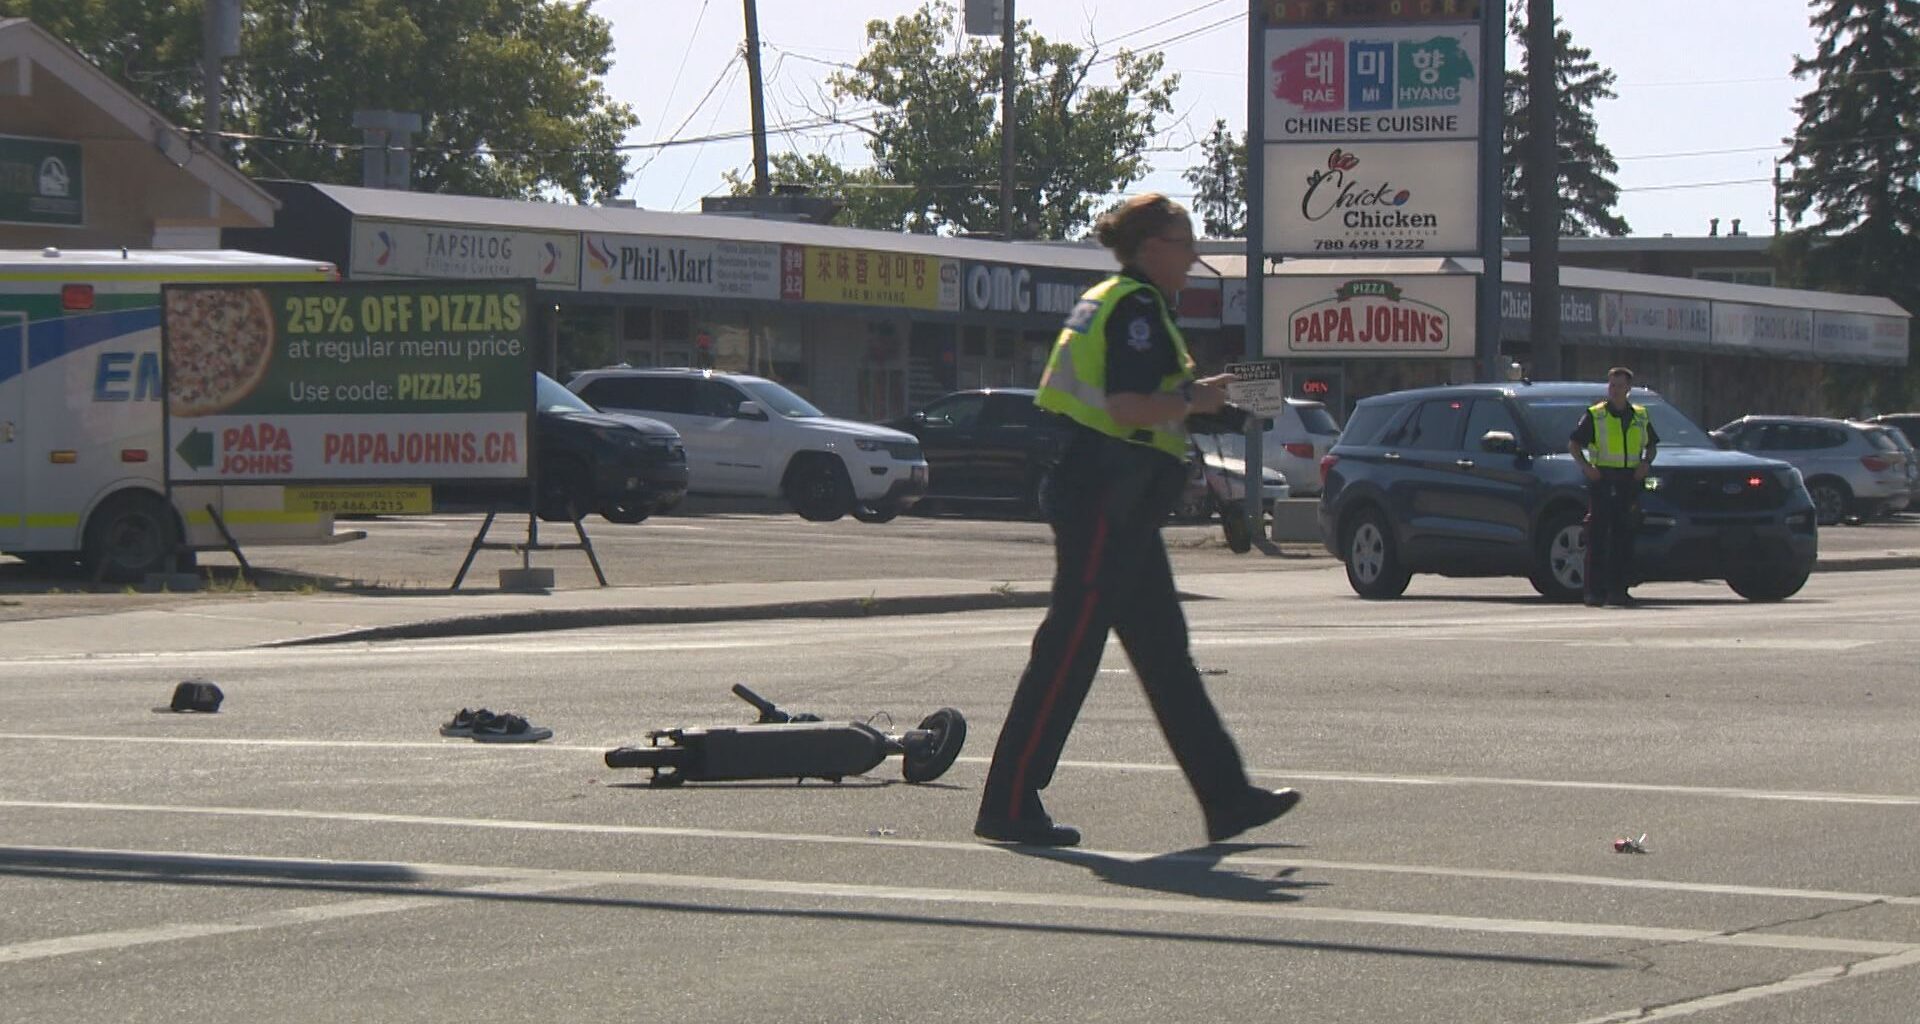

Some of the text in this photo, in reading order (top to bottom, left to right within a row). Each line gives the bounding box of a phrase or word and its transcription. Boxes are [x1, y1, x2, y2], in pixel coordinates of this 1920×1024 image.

[1303, 48, 1446, 84] 래 미 향
[1302, 86, 1457, 103] RAE MI HYANG
[1284, 114, 1459, 135] CHINESE CUISINE
[1301, 169, 1393, 222] Chick
[1343, 211, 1438, 229] Chicken
[427, 233, 512, 259] TAPSILOG
[1315, 239, 1425, 250] 780 498 1222
[620, 246, 713, 283] Phil-Mart
[968, 264, 1030, 312] OMG
[1352, 283, 1386, 295] PIZZA
[286, 293, 521, 333] 25% OFF PIZZAS
[1295, 304, 1444, 343] PAPA JOHN'S
[288, 341, 311, 358] at
[315, 337, 394, 363] regular
[400, 341, 461, 357] menu
[290, 374, 481, 402] Use code: PIZZA25
[1237, 370, 1276, 380] ROPERTY
[1303, 380, 1328, 392] OPEN
[223, 425, 292, 452] PAPA
[324, 431, 518, 464] PAPAJOHNS.CA
[220, 453, 292, 474] JOHNS
